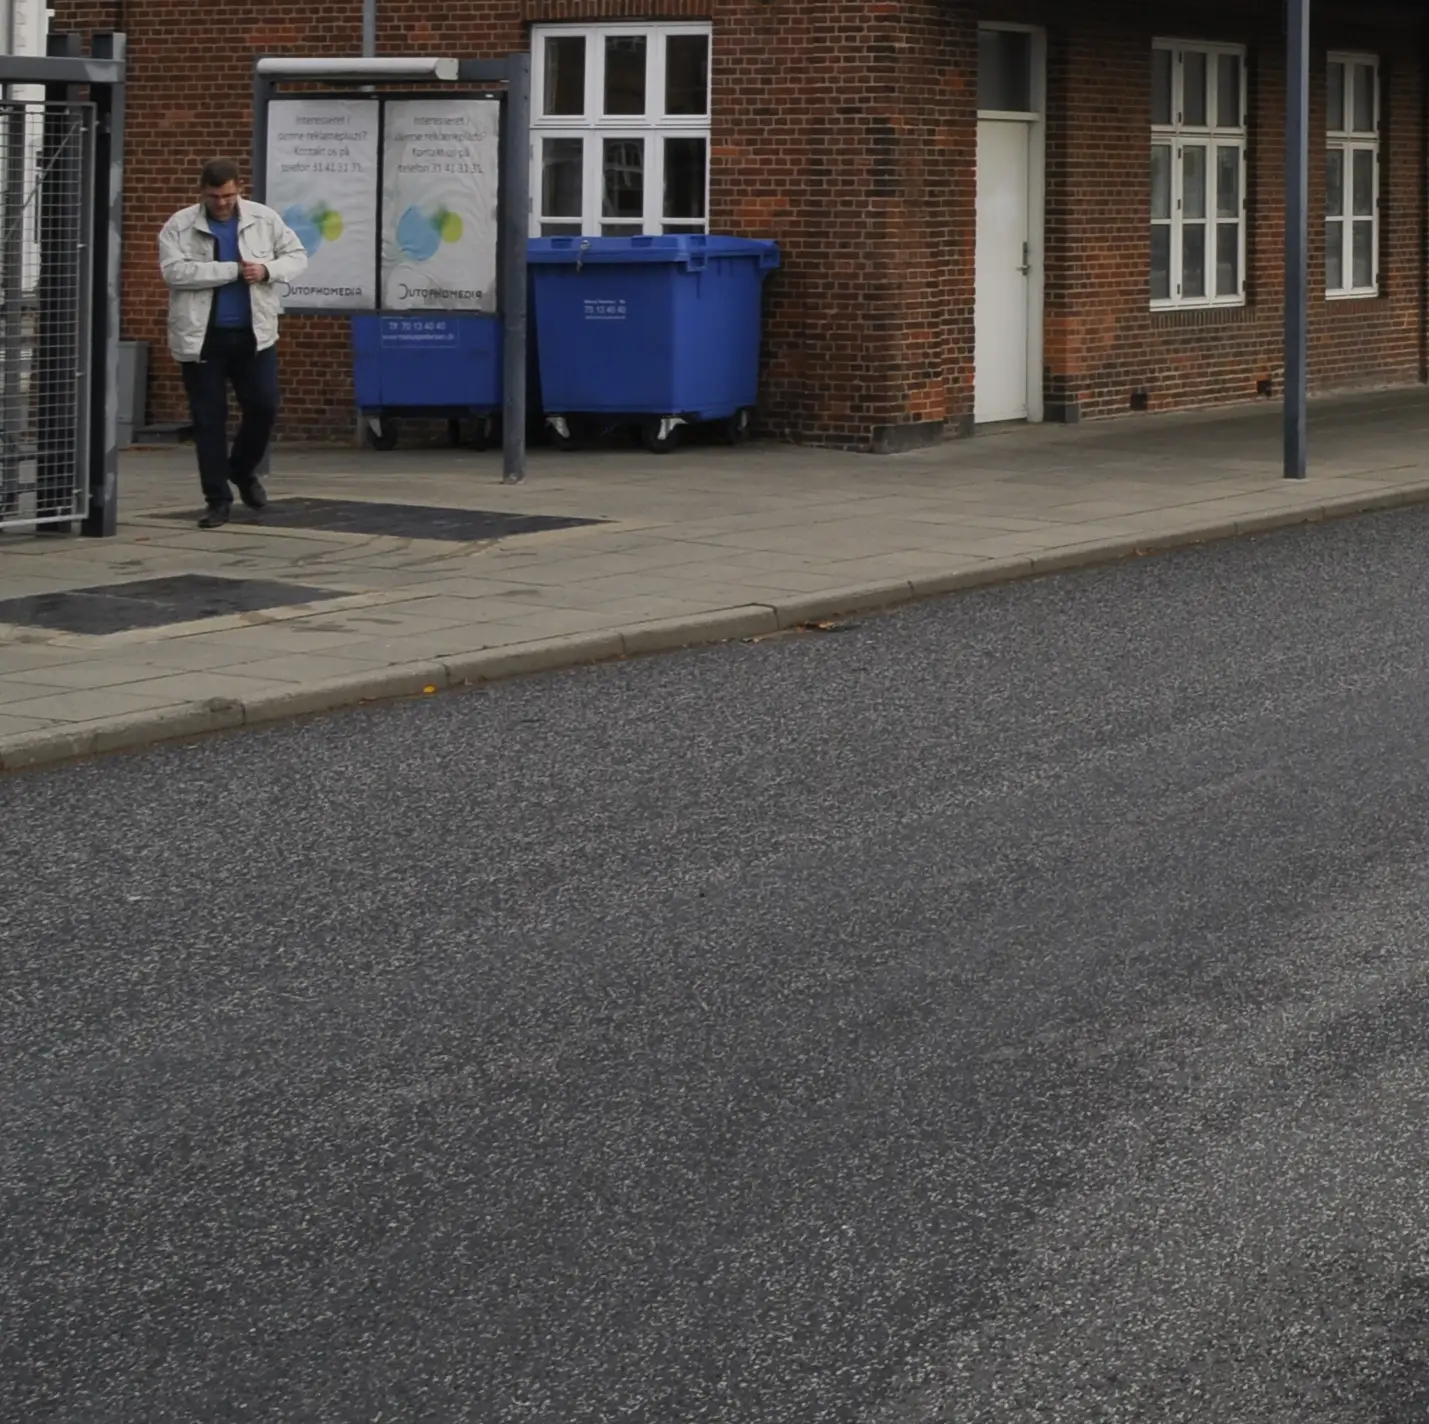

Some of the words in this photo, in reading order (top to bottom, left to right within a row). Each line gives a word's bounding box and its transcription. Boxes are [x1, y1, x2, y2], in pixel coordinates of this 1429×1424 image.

[402, 321, 412, 331] 70
[424, 321, 435, 331] 40
[436, 321, 446, 331] 40
